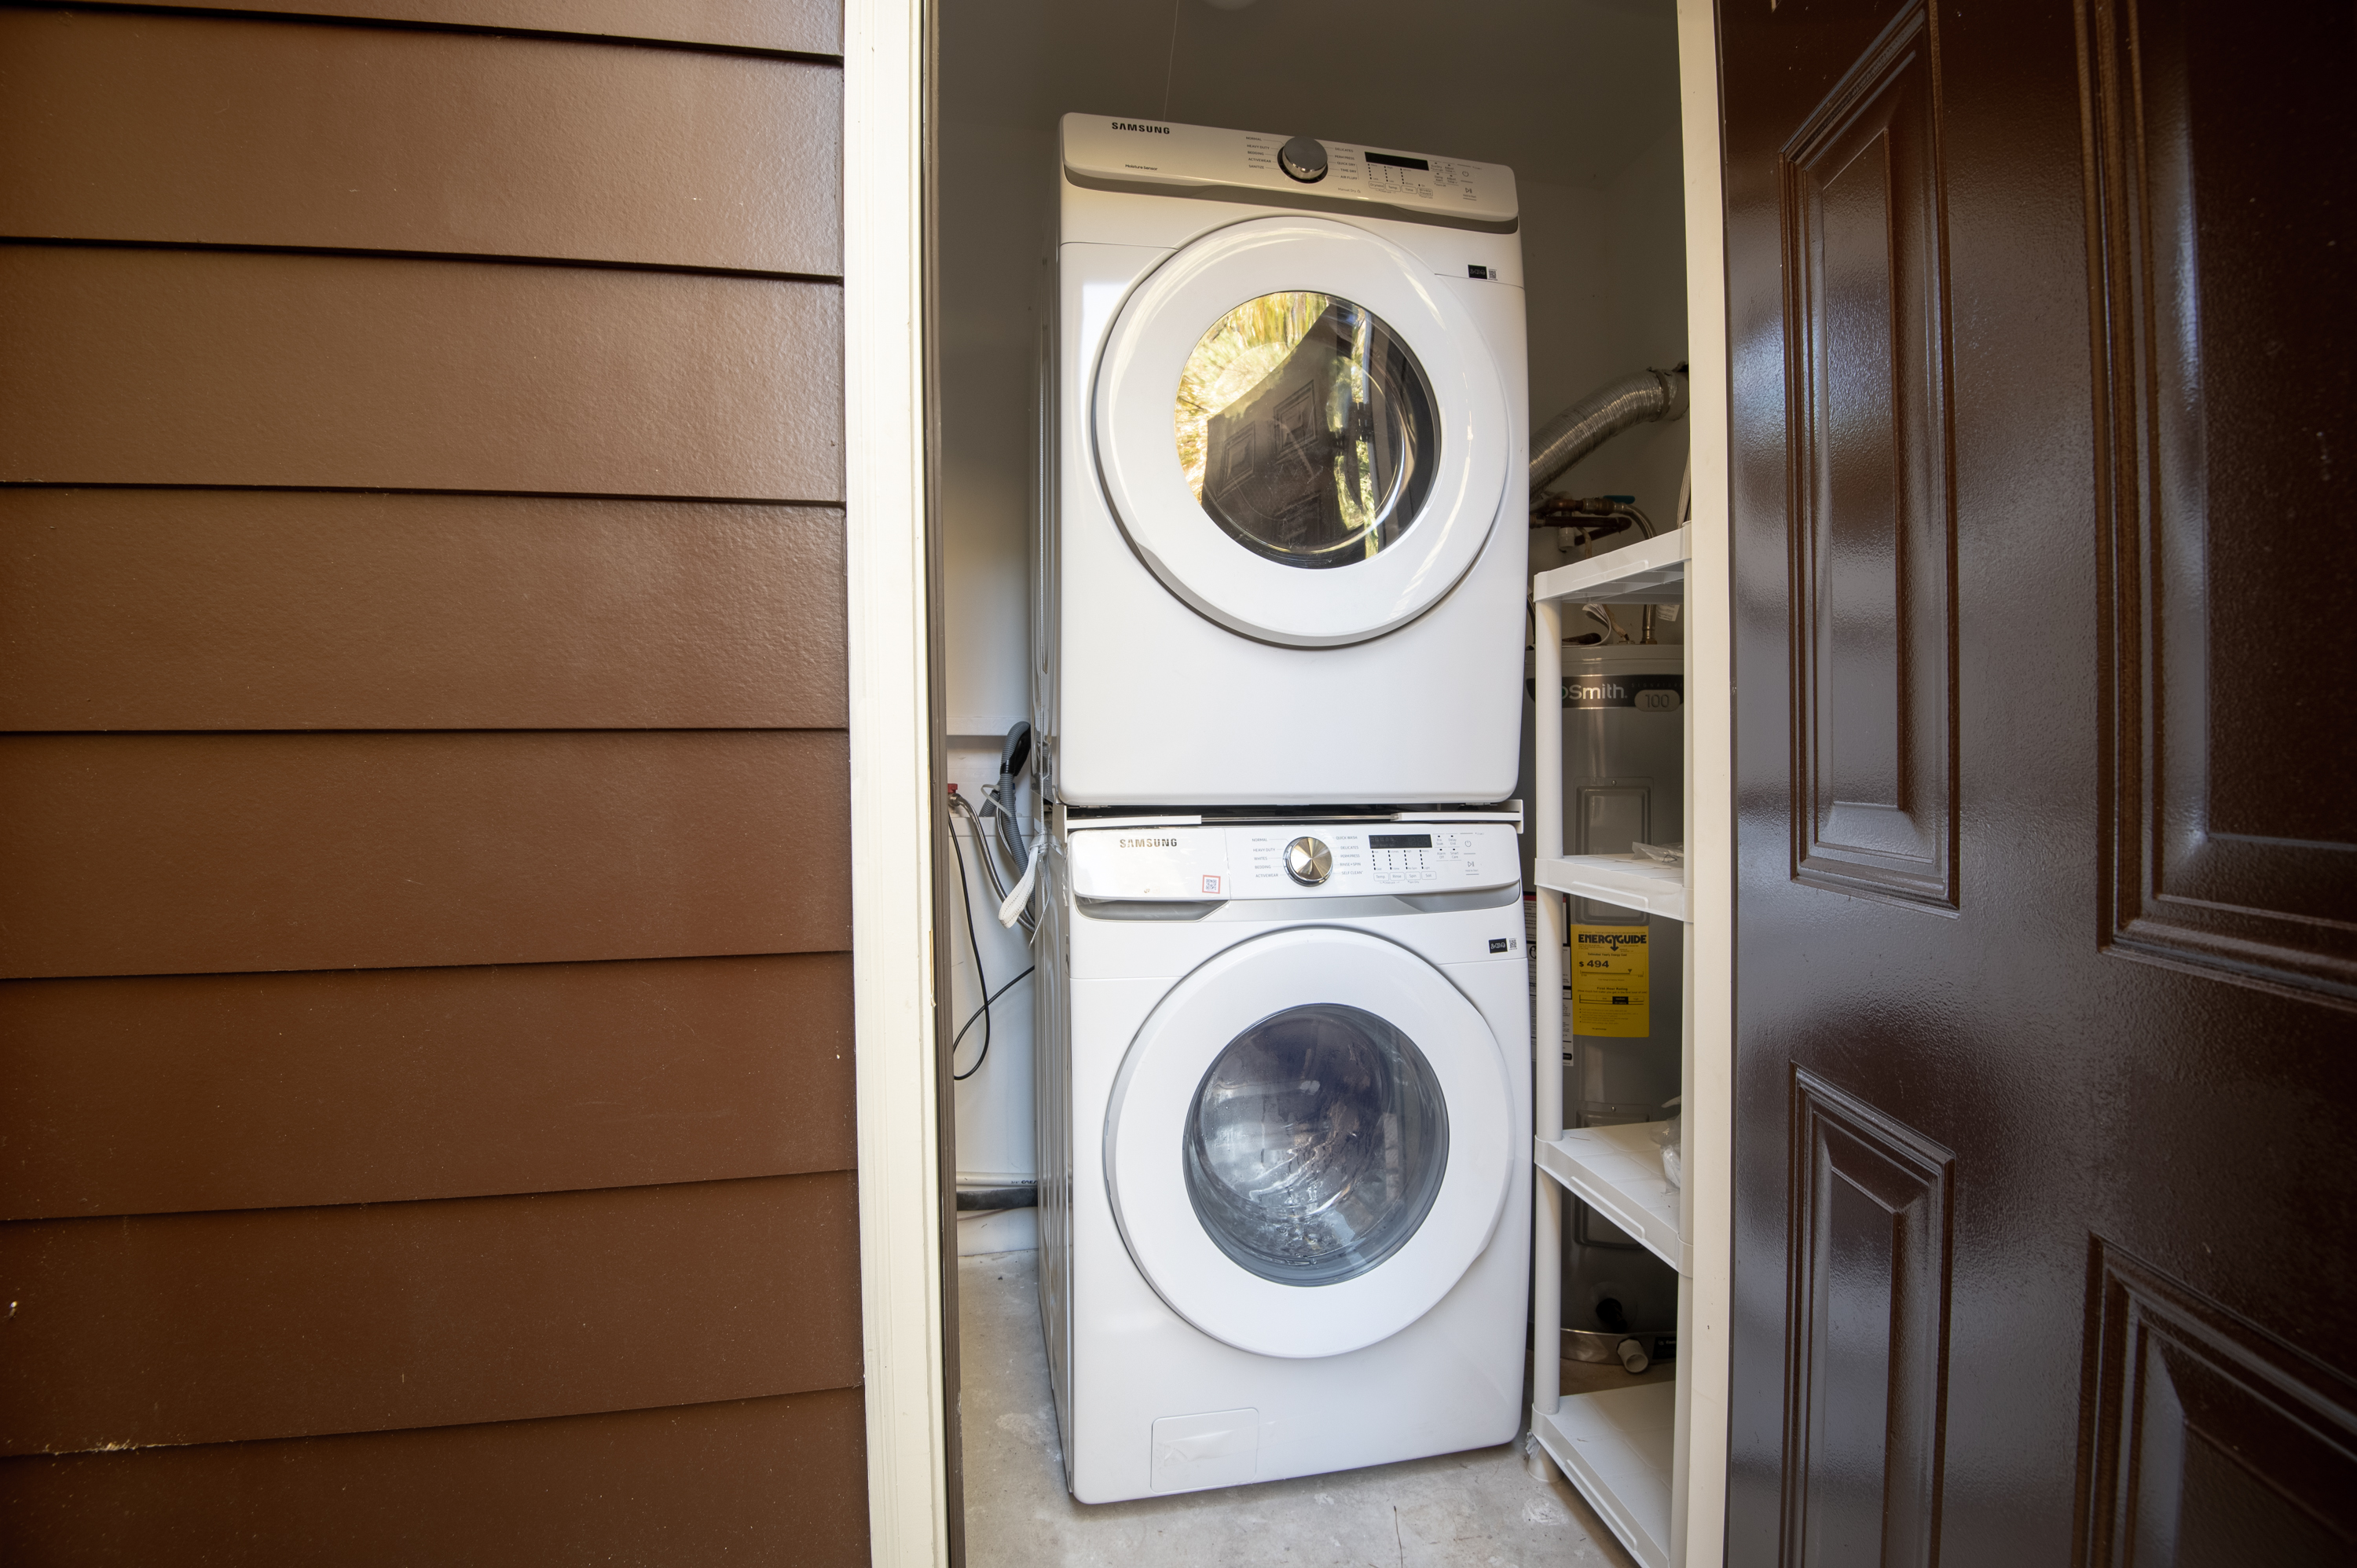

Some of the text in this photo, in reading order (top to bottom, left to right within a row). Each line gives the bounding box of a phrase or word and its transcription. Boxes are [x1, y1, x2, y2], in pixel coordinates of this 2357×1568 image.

[1112, 122, 1170, 134] SAMSUNG
[1645, 694, 1669, 708] 100
[1120, 838, 1177, 848] SAMSUNG
[1578, 934, 1647, 944] ENERGYGUIDE
